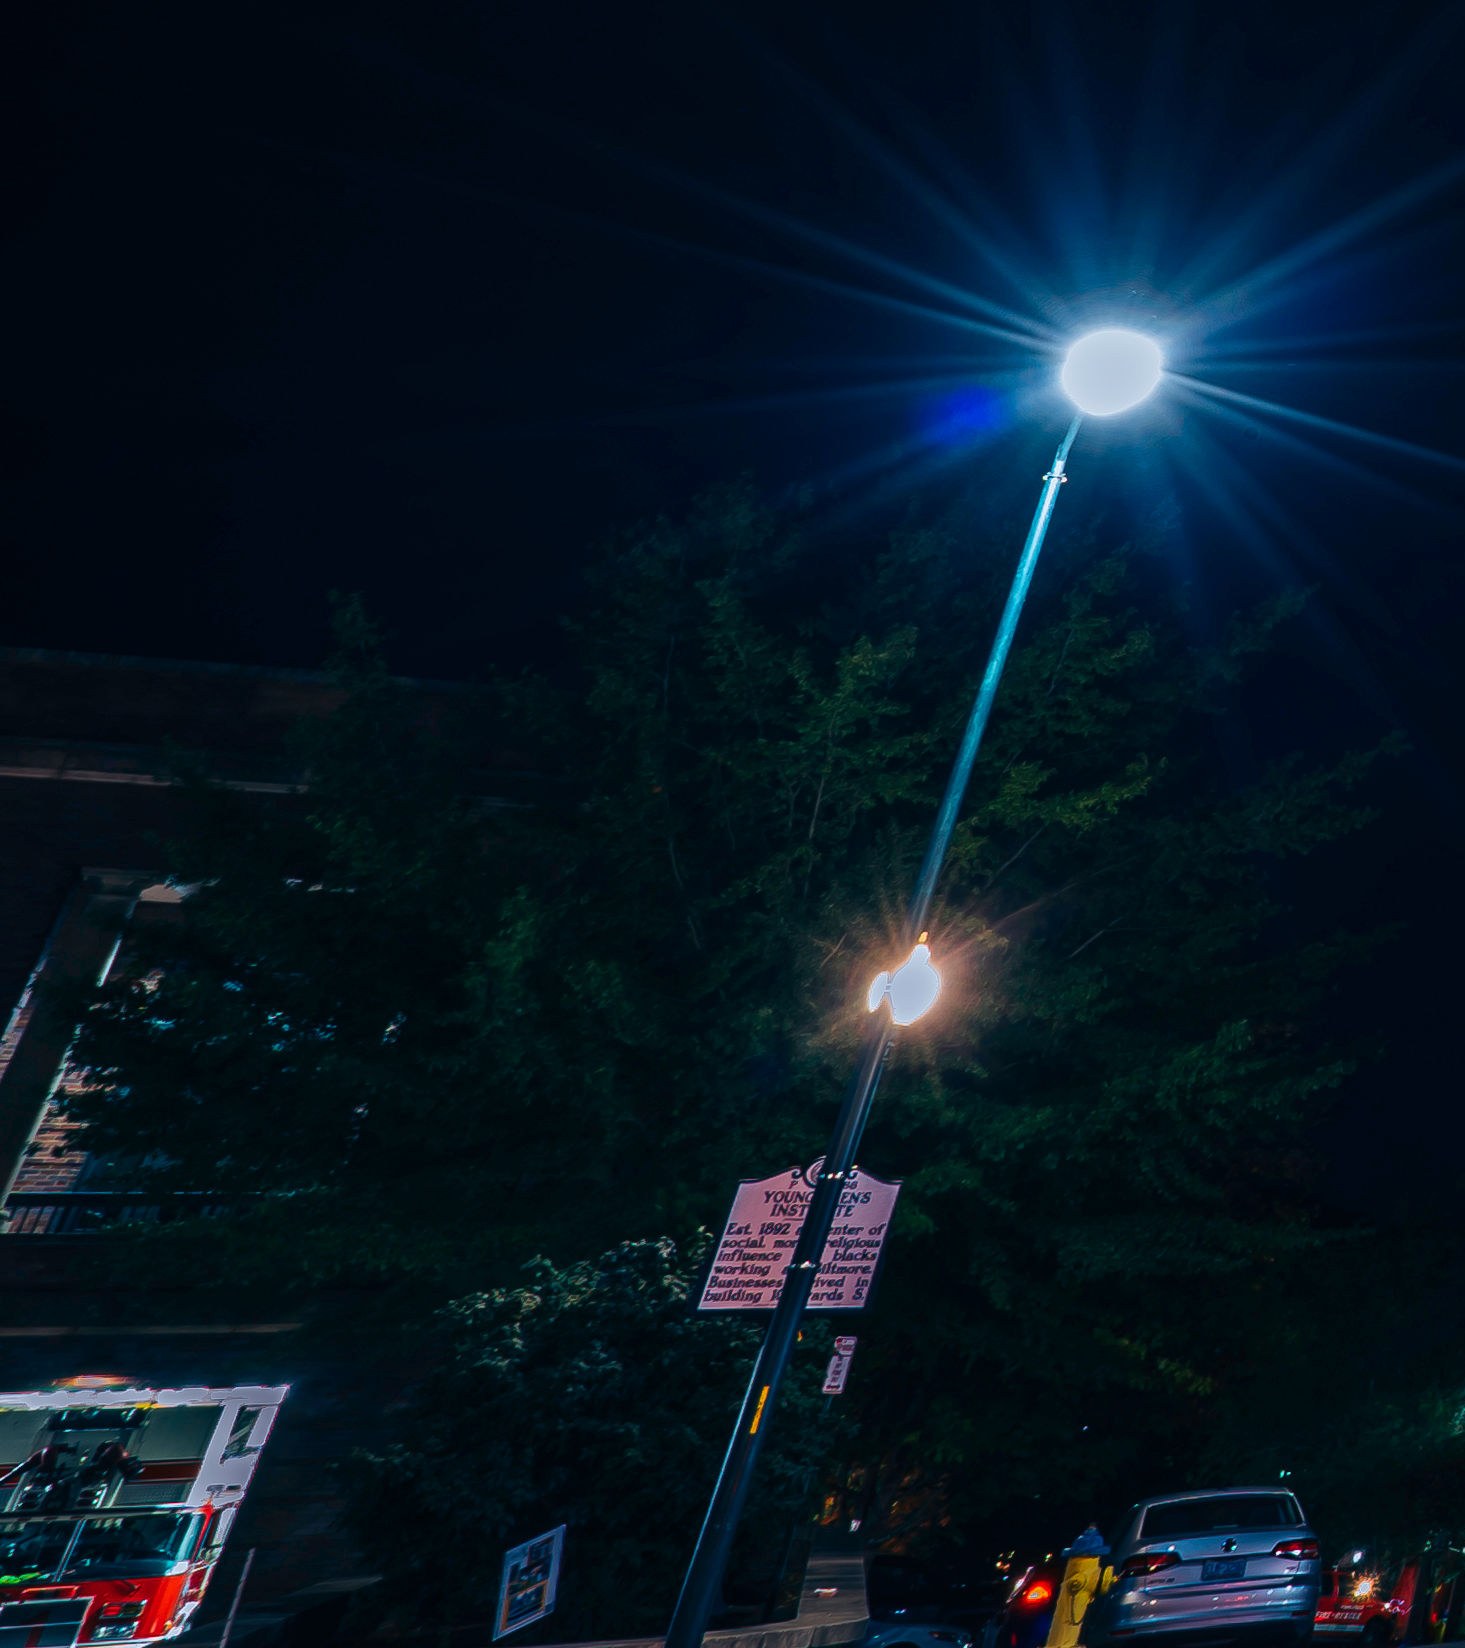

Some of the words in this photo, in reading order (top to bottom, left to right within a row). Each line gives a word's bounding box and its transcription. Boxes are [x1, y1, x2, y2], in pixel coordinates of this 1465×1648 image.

[840, 1192, 873, 1204] EN'S
[758, 1222, 791, 1235] 1892
[868, 1223, 887, 1236] of
[717, 1249, 783, 1262] influence
[832, 1249, 878, 1262] blacks
[714, 1263, 770, 1277] working
[706, 1276, 783, 1289] Businesses
[855, 1277, 869, 1288] in
[703, 1289, 763, 1303] building
